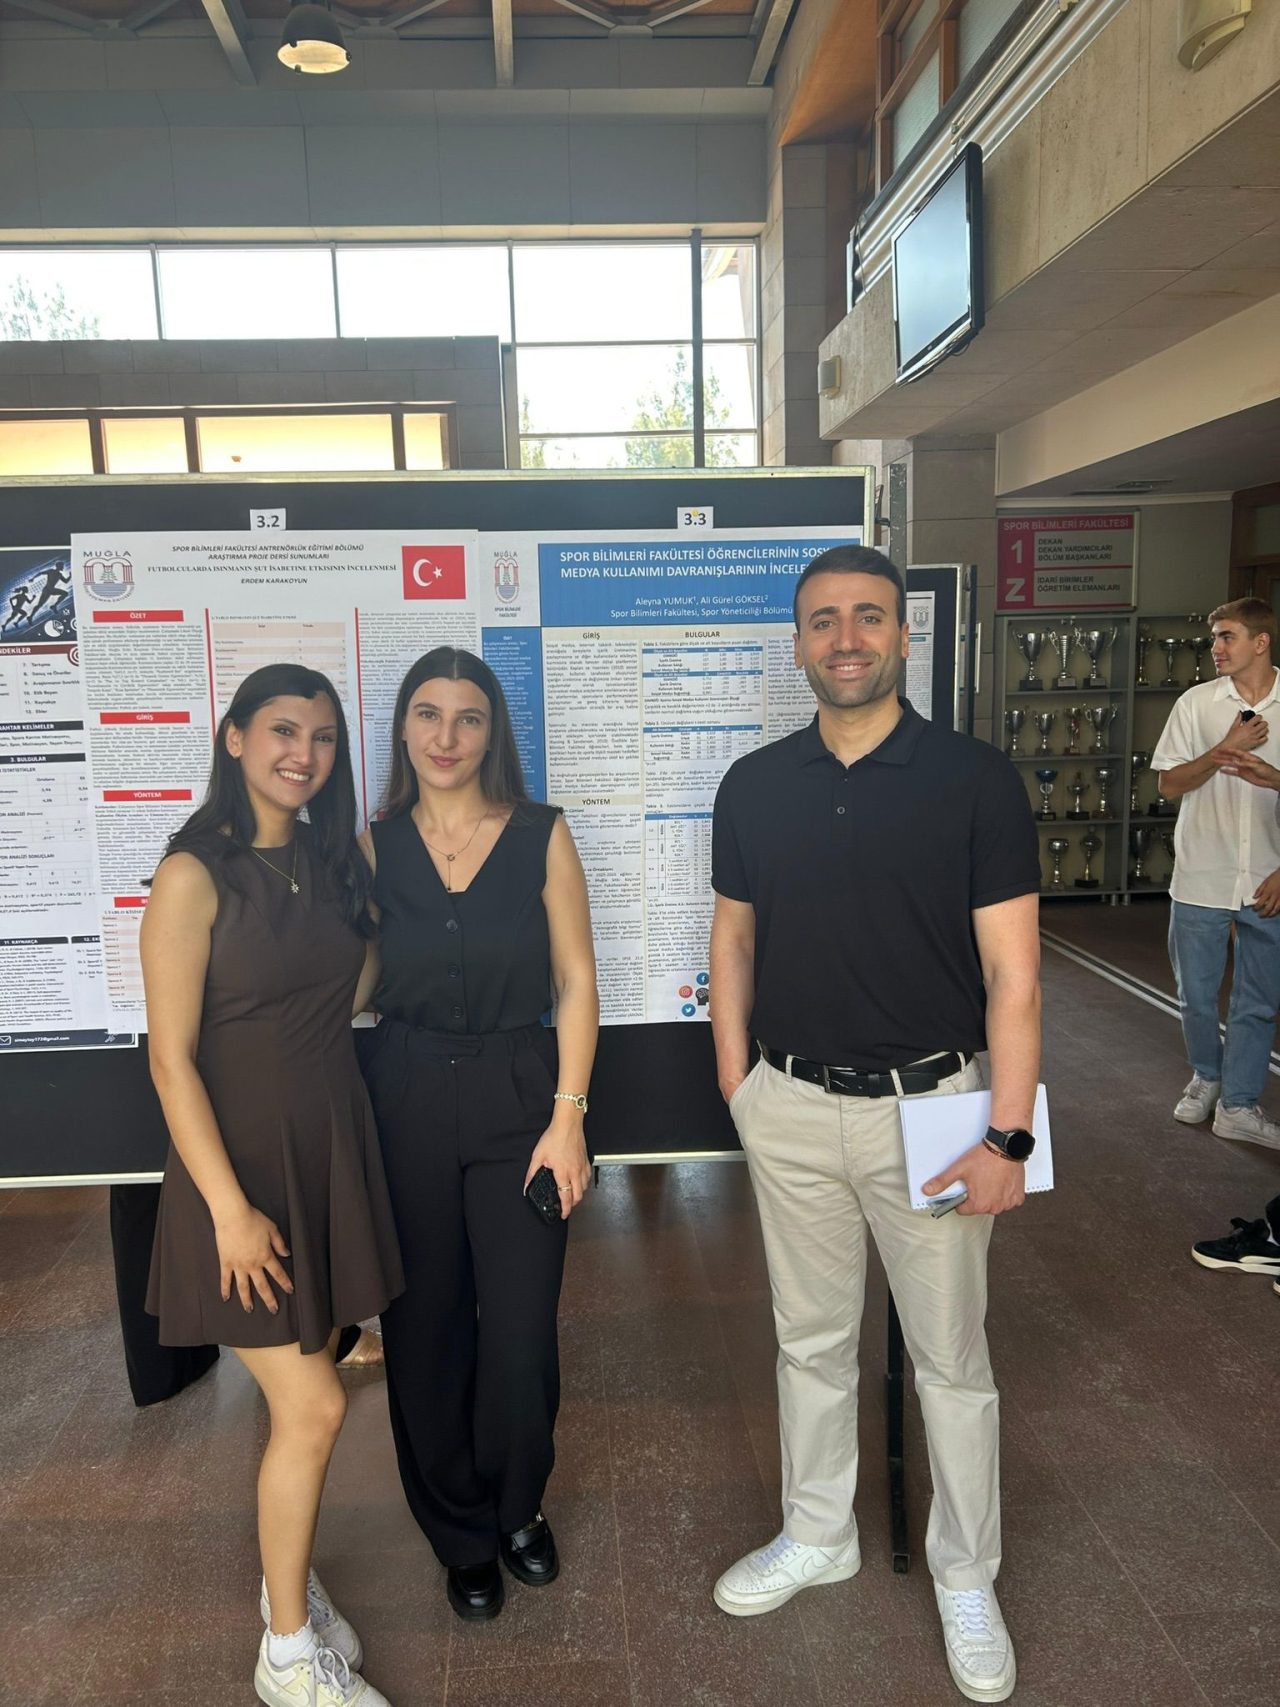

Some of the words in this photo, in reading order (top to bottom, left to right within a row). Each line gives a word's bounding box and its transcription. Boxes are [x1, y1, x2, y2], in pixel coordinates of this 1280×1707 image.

[256, 515, 280, 528] 3.2
[684, 513, 707, 526] 3.3
[1003, 522, 1029, 531] SPOR
[1032, 519, 1077, 530] BİLİMLERİ
[1080, 518, 1129, 528] FAKÜLTESİ
[191, 544, 224, 552] BİLİMLERİ
[494, 550, 518, 558] MUĞLA
[560, 551, 590, 562] SPOR
[593, 549, 646, 561] BİLİMLERİ
[649, 548, 704, 561] FAKÜLTESİ
[707, 546, 799, 560] ÖĞRENCİLERİNİN
[1011, 540, 1023, 564] 1
[1064, 545, 1113, 553] YARDIMCILARI
[1038, 553, 1064, 561] BÖLÜM
[1066, 553, 1112, 561] BAŞKANLARI
[561, 568, 601, 578] MEDYA
[603, 567, 664, 577] KULLANIMI
[667, 565, 766, 578] DAVRANIŞLARININ
[1037, 576, 1058, 584] İDARİ
[1059, 576, 1094, 584] BİRİMLER
[1005, 577, 1026, 602] Z
[1037, 584, 1071, 592] ÖĞRETİM
[635, 598, 662, 607] Aleyna
[700, 596, 711, 605] Ali
[712, 596, 734, 604] Gürel
[610, 609, 629, 619] Spor
[630, 609, 662, 617] Bilimleri
[663, 608, 700, 617] Fakültesi,
[701, 608, 719, 617] Spor
[720, 607, 762, 617] Yöneticiliği
[763, 606, 793, 615] Bölümü
[582, 632, 601, 640] GİRİŞ
